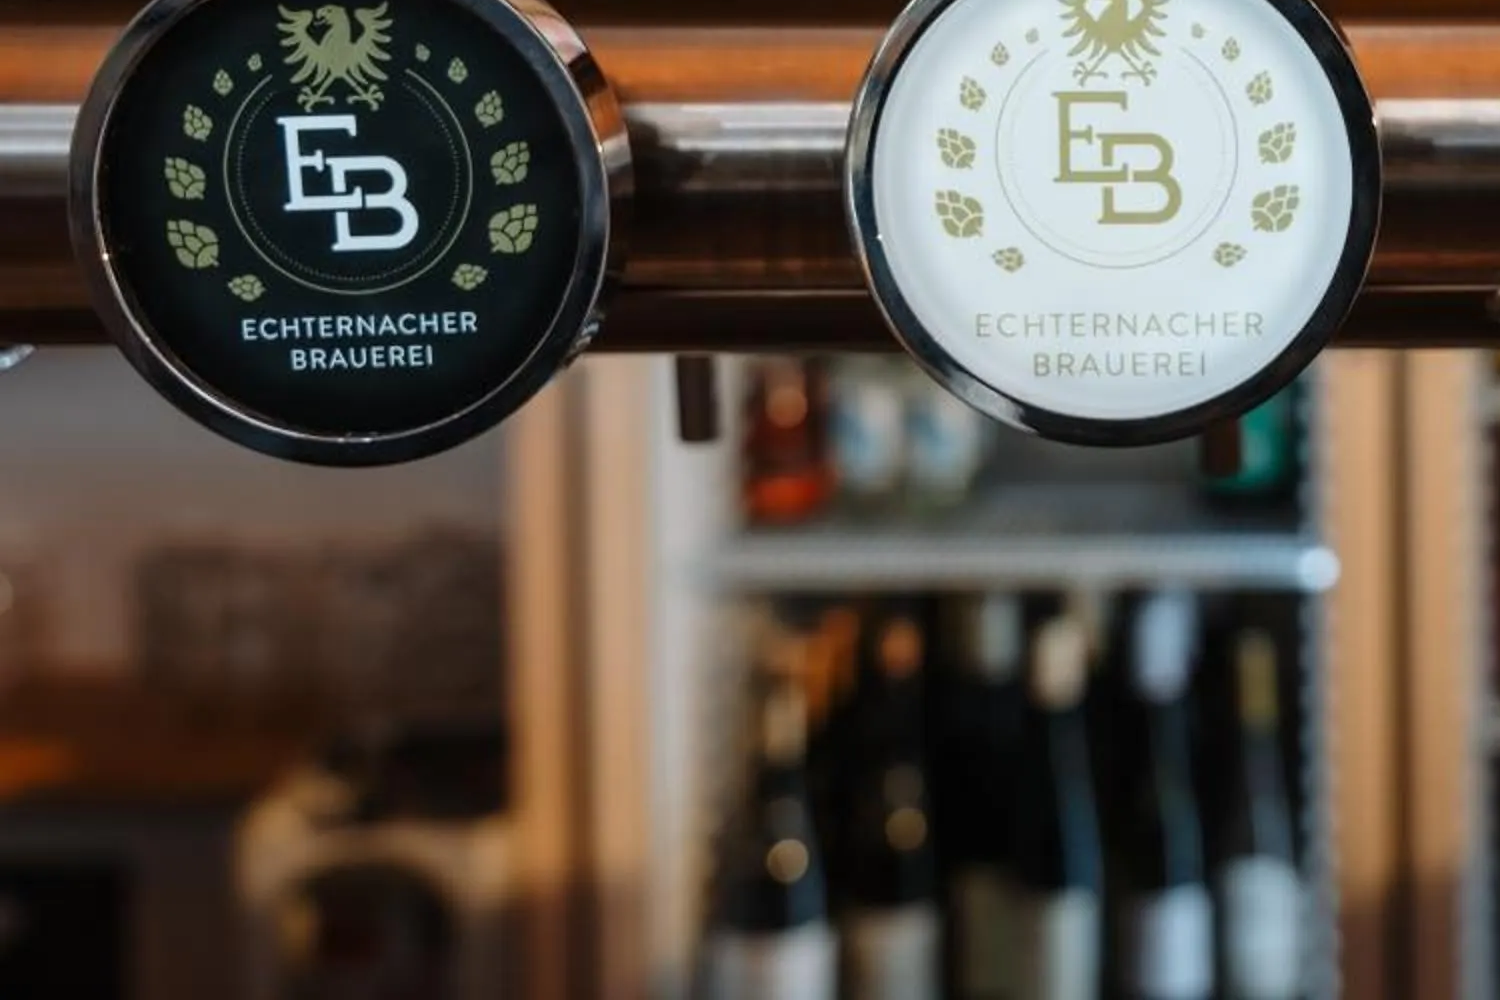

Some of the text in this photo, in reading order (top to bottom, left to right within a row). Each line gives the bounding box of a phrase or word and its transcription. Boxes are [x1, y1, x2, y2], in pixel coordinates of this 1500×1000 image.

[241, 311, 478, 340] ECHTERNACHER
[975, 311, 1264, 339] ECHTERNACHER
[290, 344, 434, 371] BRAUEREI
[1032, 351, 1207, 378] BRAUEREI
